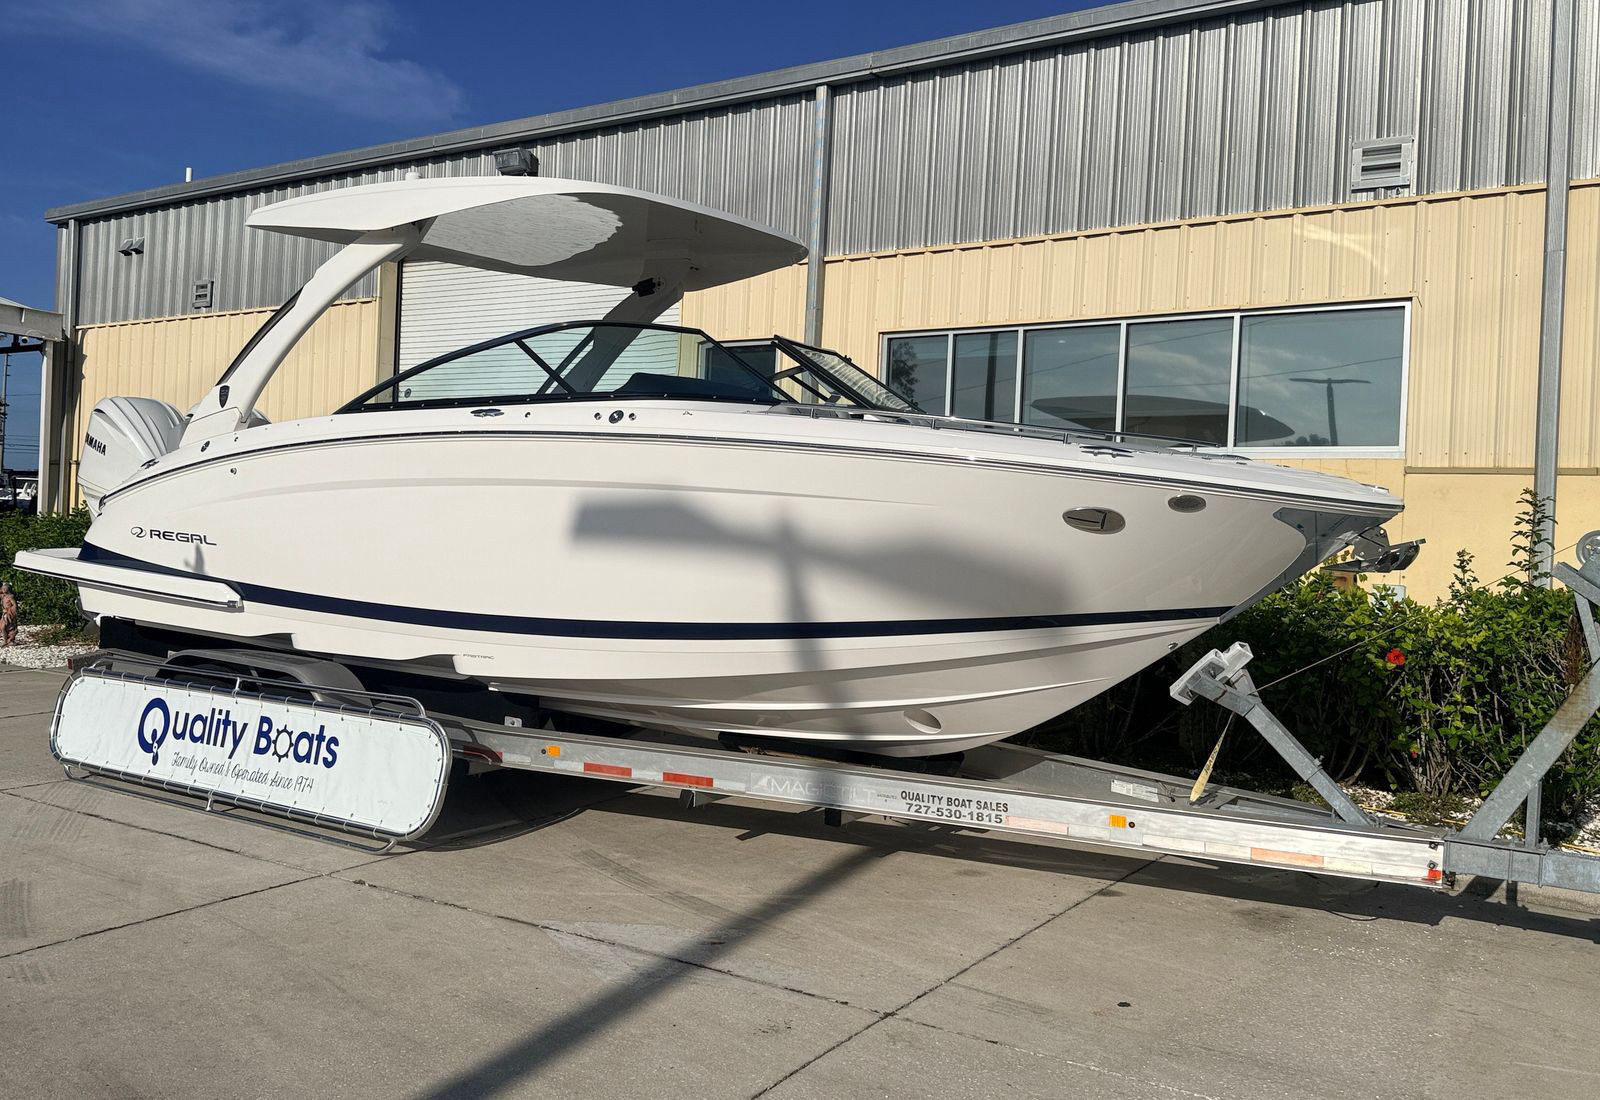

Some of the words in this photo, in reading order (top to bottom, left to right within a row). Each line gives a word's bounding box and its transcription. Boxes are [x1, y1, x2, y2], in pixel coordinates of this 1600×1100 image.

[84, 431, 106, 456] AMAHA
[149, 529, 217, 546] REGAL
[137, 697, 248, 766] Quality
[253, 715, 339, 769] Boats
[172, 752, 197, 775] Family
[199, 757, 225, 776] Owned
[230, 764, 269, 784] Operated
[293, 775, 314, 793] 1974
[901, 790, 943, 805] QUALITY
[946, 797, 973, 809] BOAT
[976, 800, 1008, 813] SALES
[905, 802, 1003, 824] 727-530-1815
